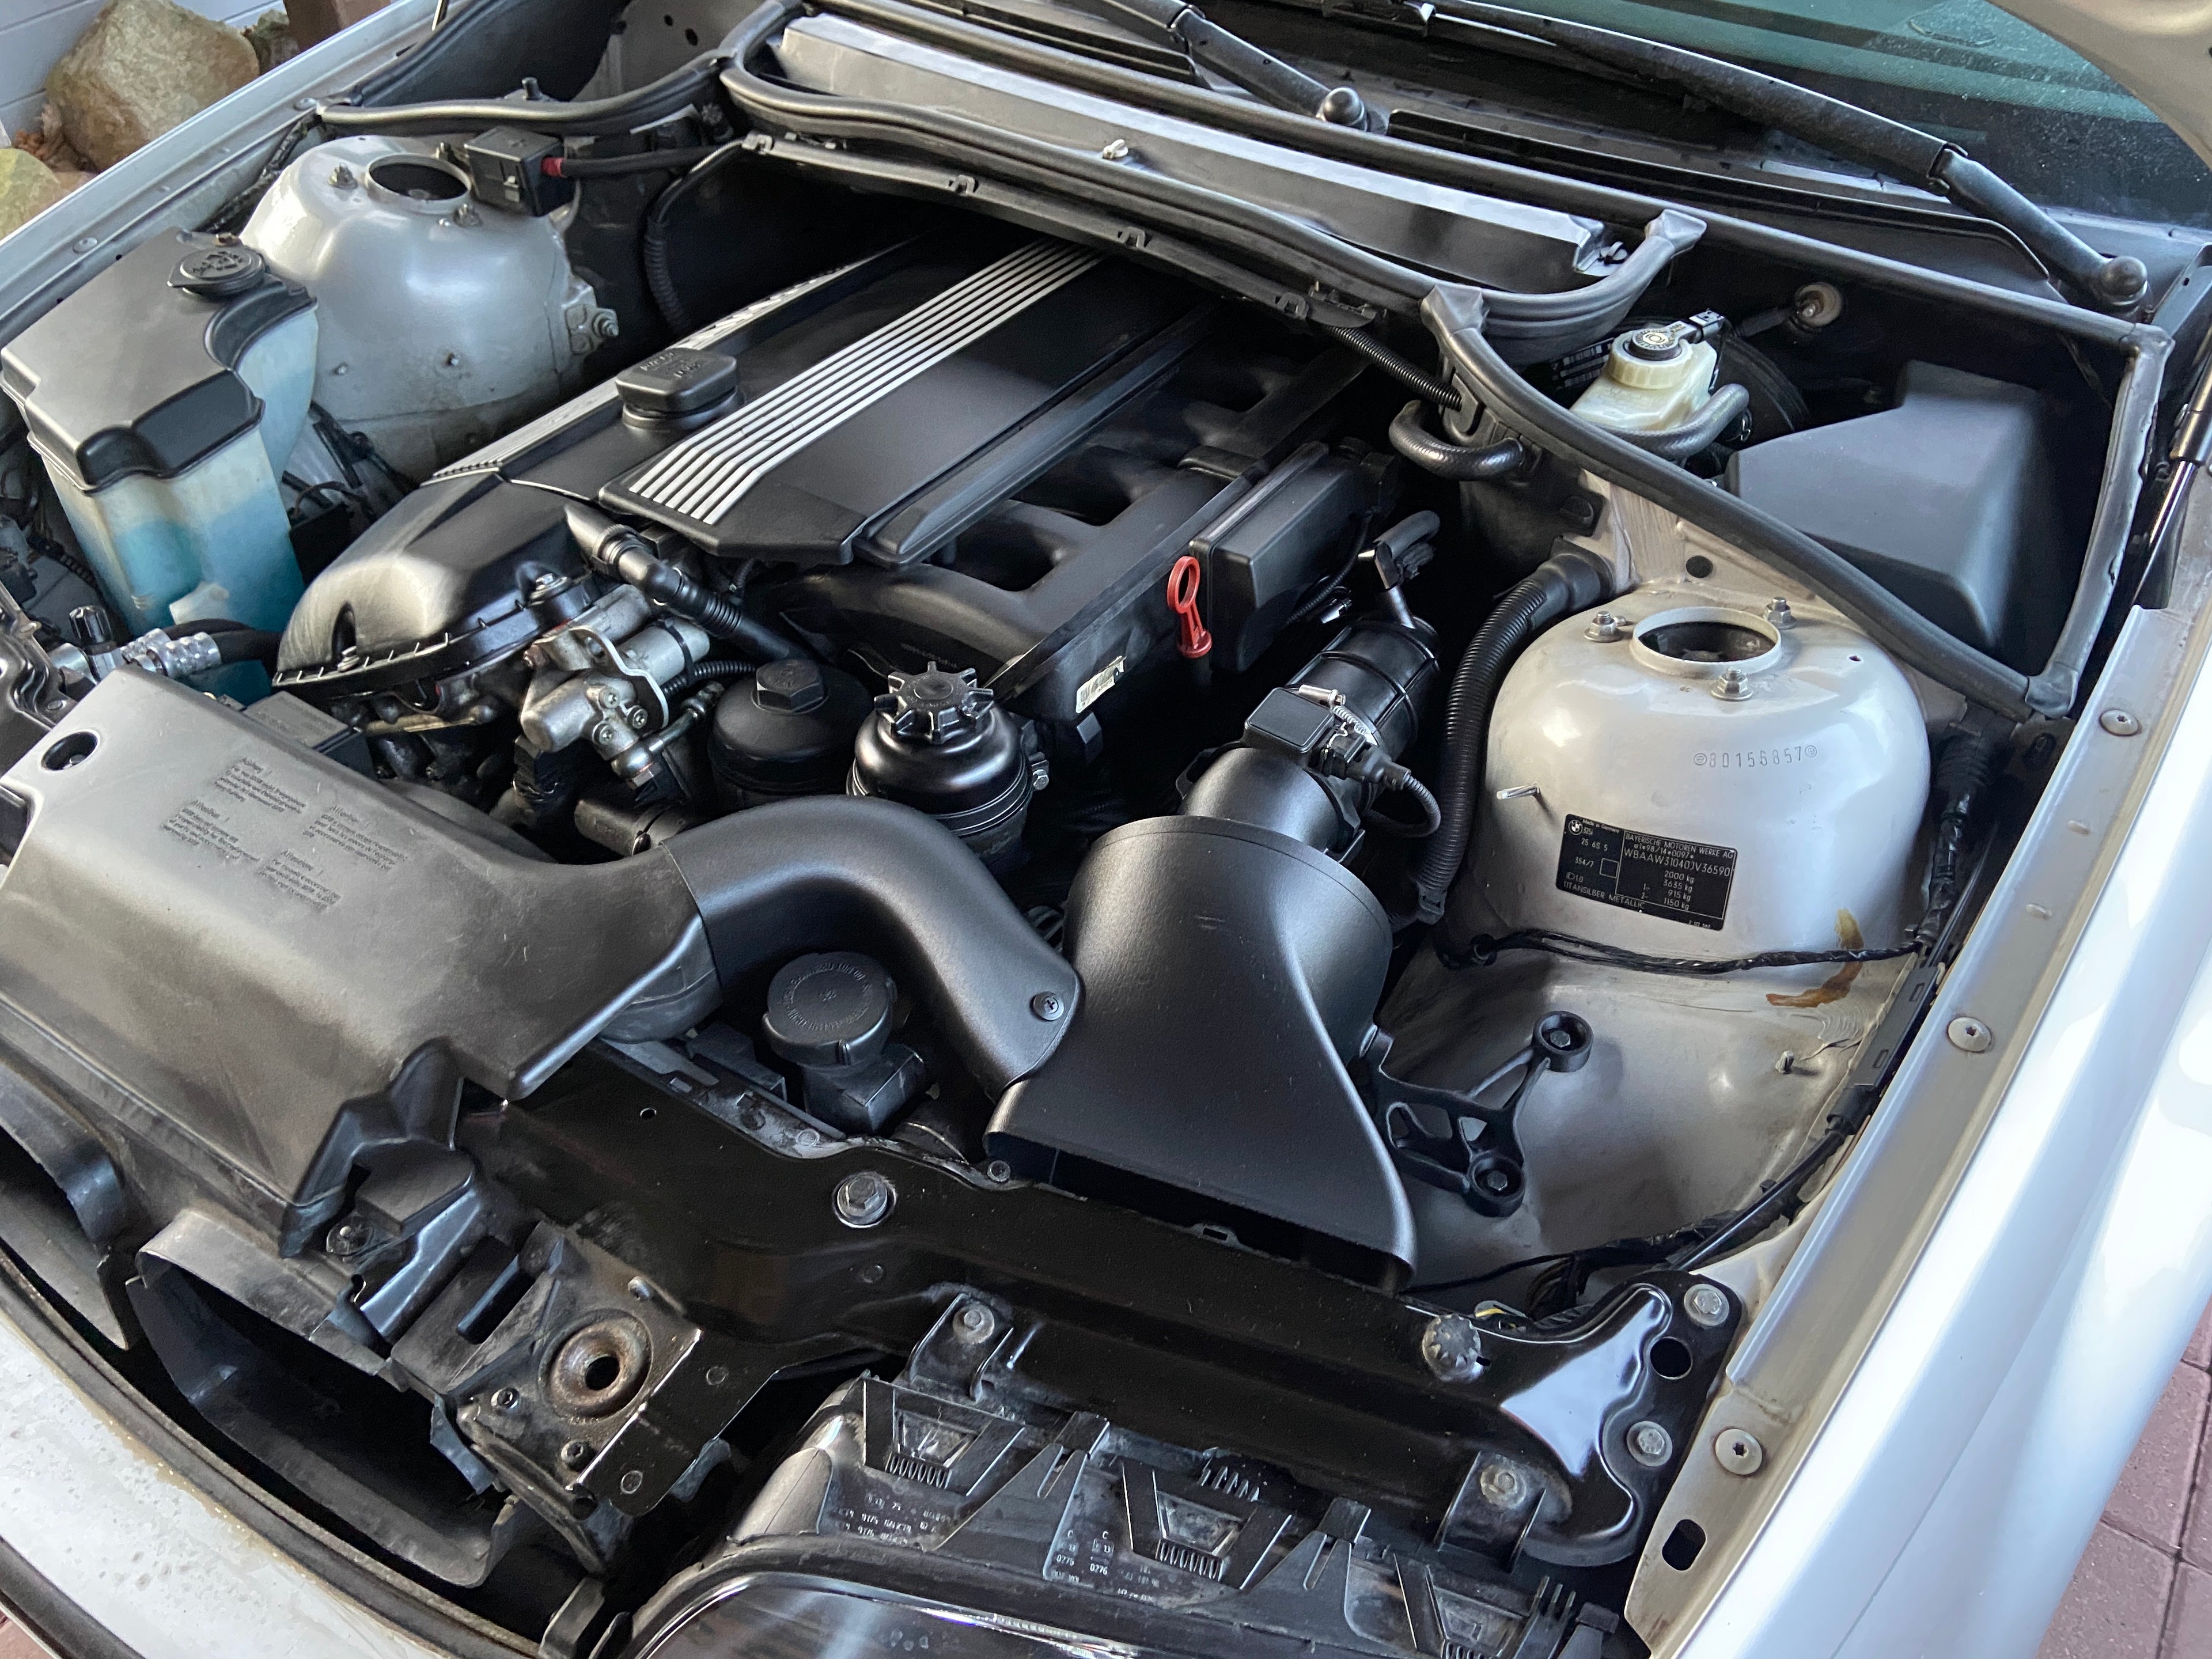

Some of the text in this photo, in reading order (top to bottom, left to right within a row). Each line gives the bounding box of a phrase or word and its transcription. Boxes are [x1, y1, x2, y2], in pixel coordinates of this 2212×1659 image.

[1664, 841, 1697, 853] MOTOREN
[1699, 847, 1720, 857] WERKE
[1722, 851, 1734, 859] AG
[1664, 870, 1694, 884] 2000 kg
[1663, 879, 1692, 893] 3635 kg
[1563, 880, 1646, 910] TITANSILBER METALLIC
[1683, 893, 1691, 903] kg
[1681, 902, 1690, 911] kg
